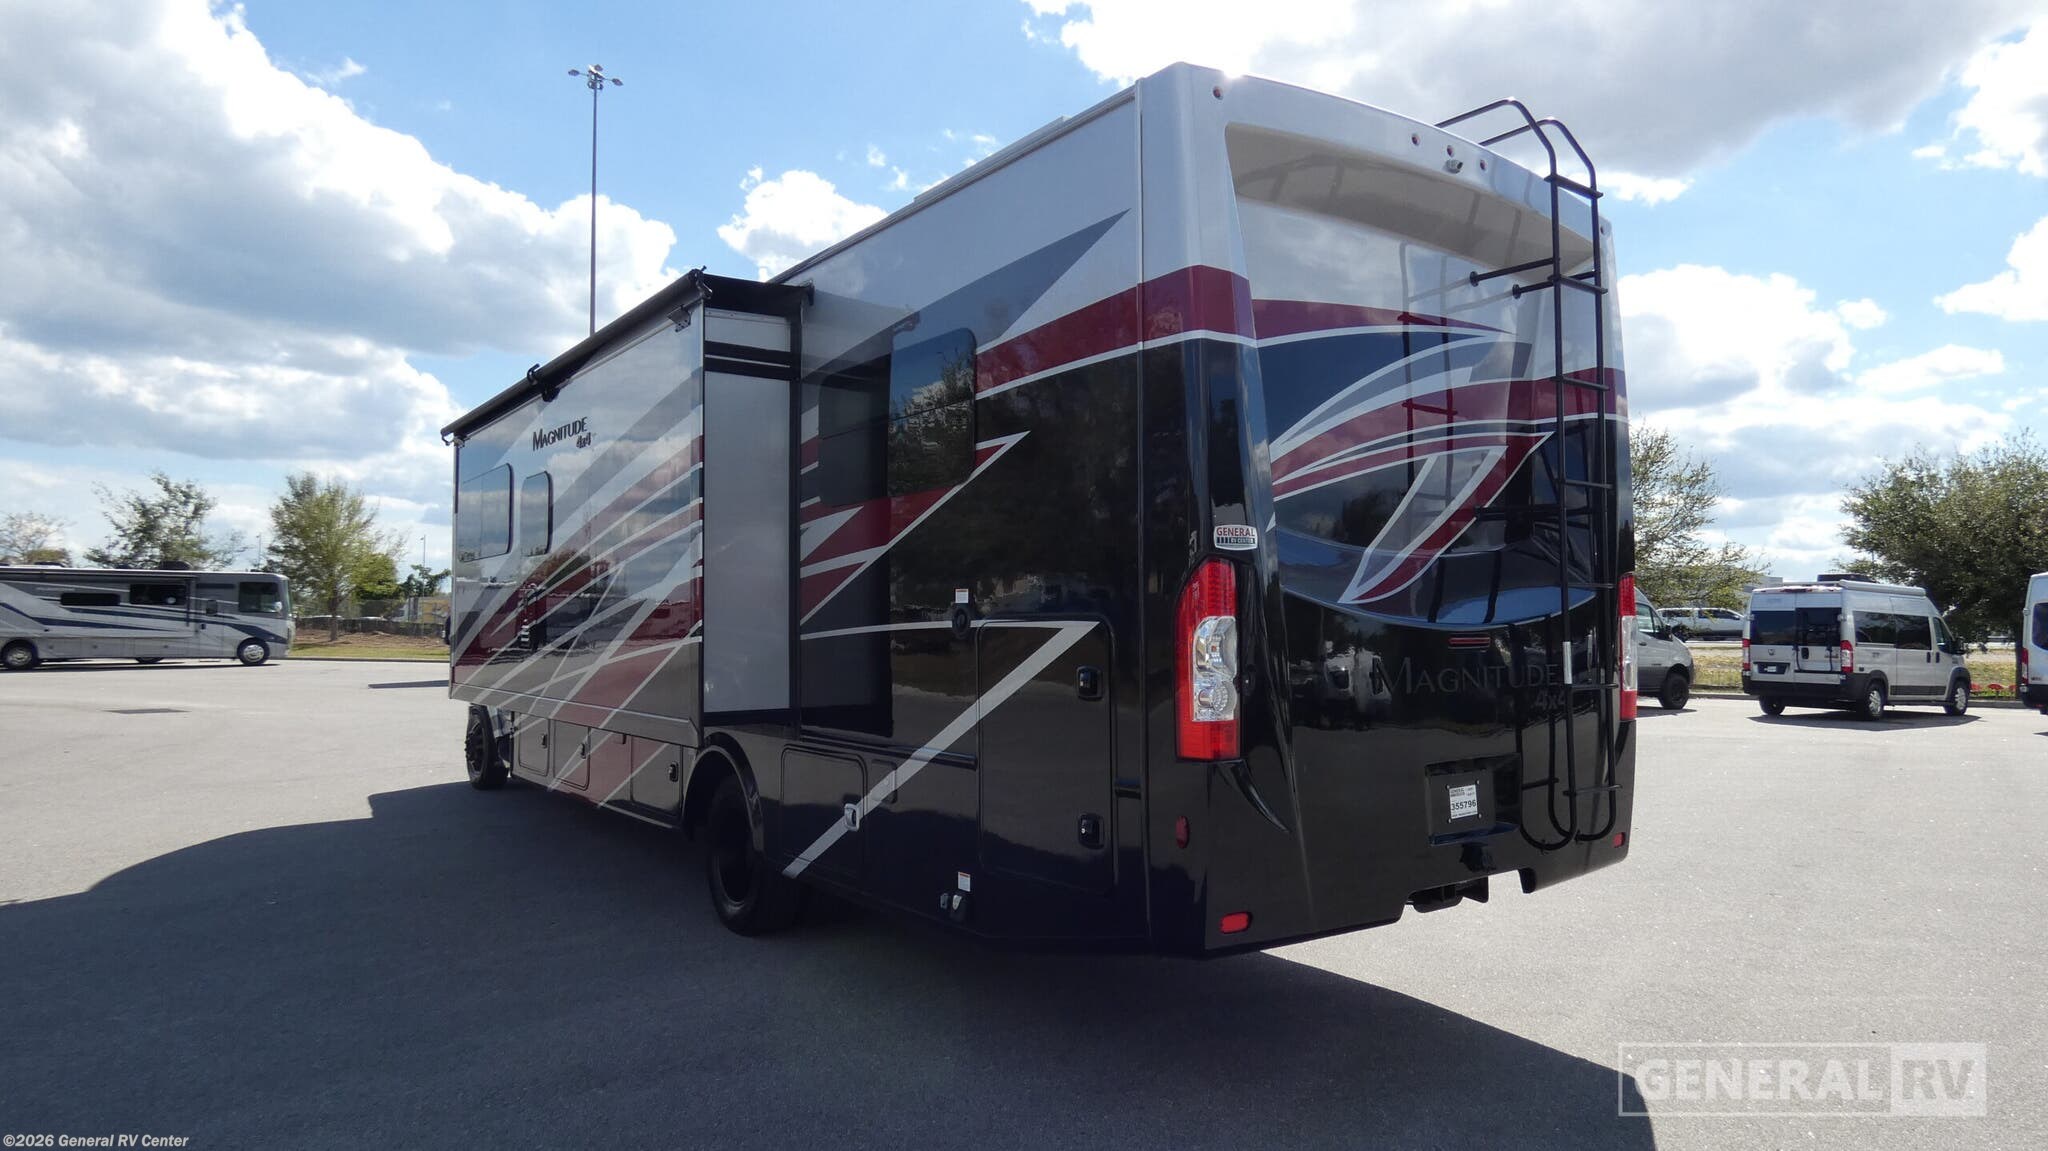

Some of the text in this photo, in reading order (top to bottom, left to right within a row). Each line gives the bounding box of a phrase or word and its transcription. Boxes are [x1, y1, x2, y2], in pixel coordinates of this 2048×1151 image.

[533, 417, 587, 451] MAGNITUDE
[1216, 527, 1255, 537] GENERAL
[1372, 656, 1559, 694] MAGNITUDE
